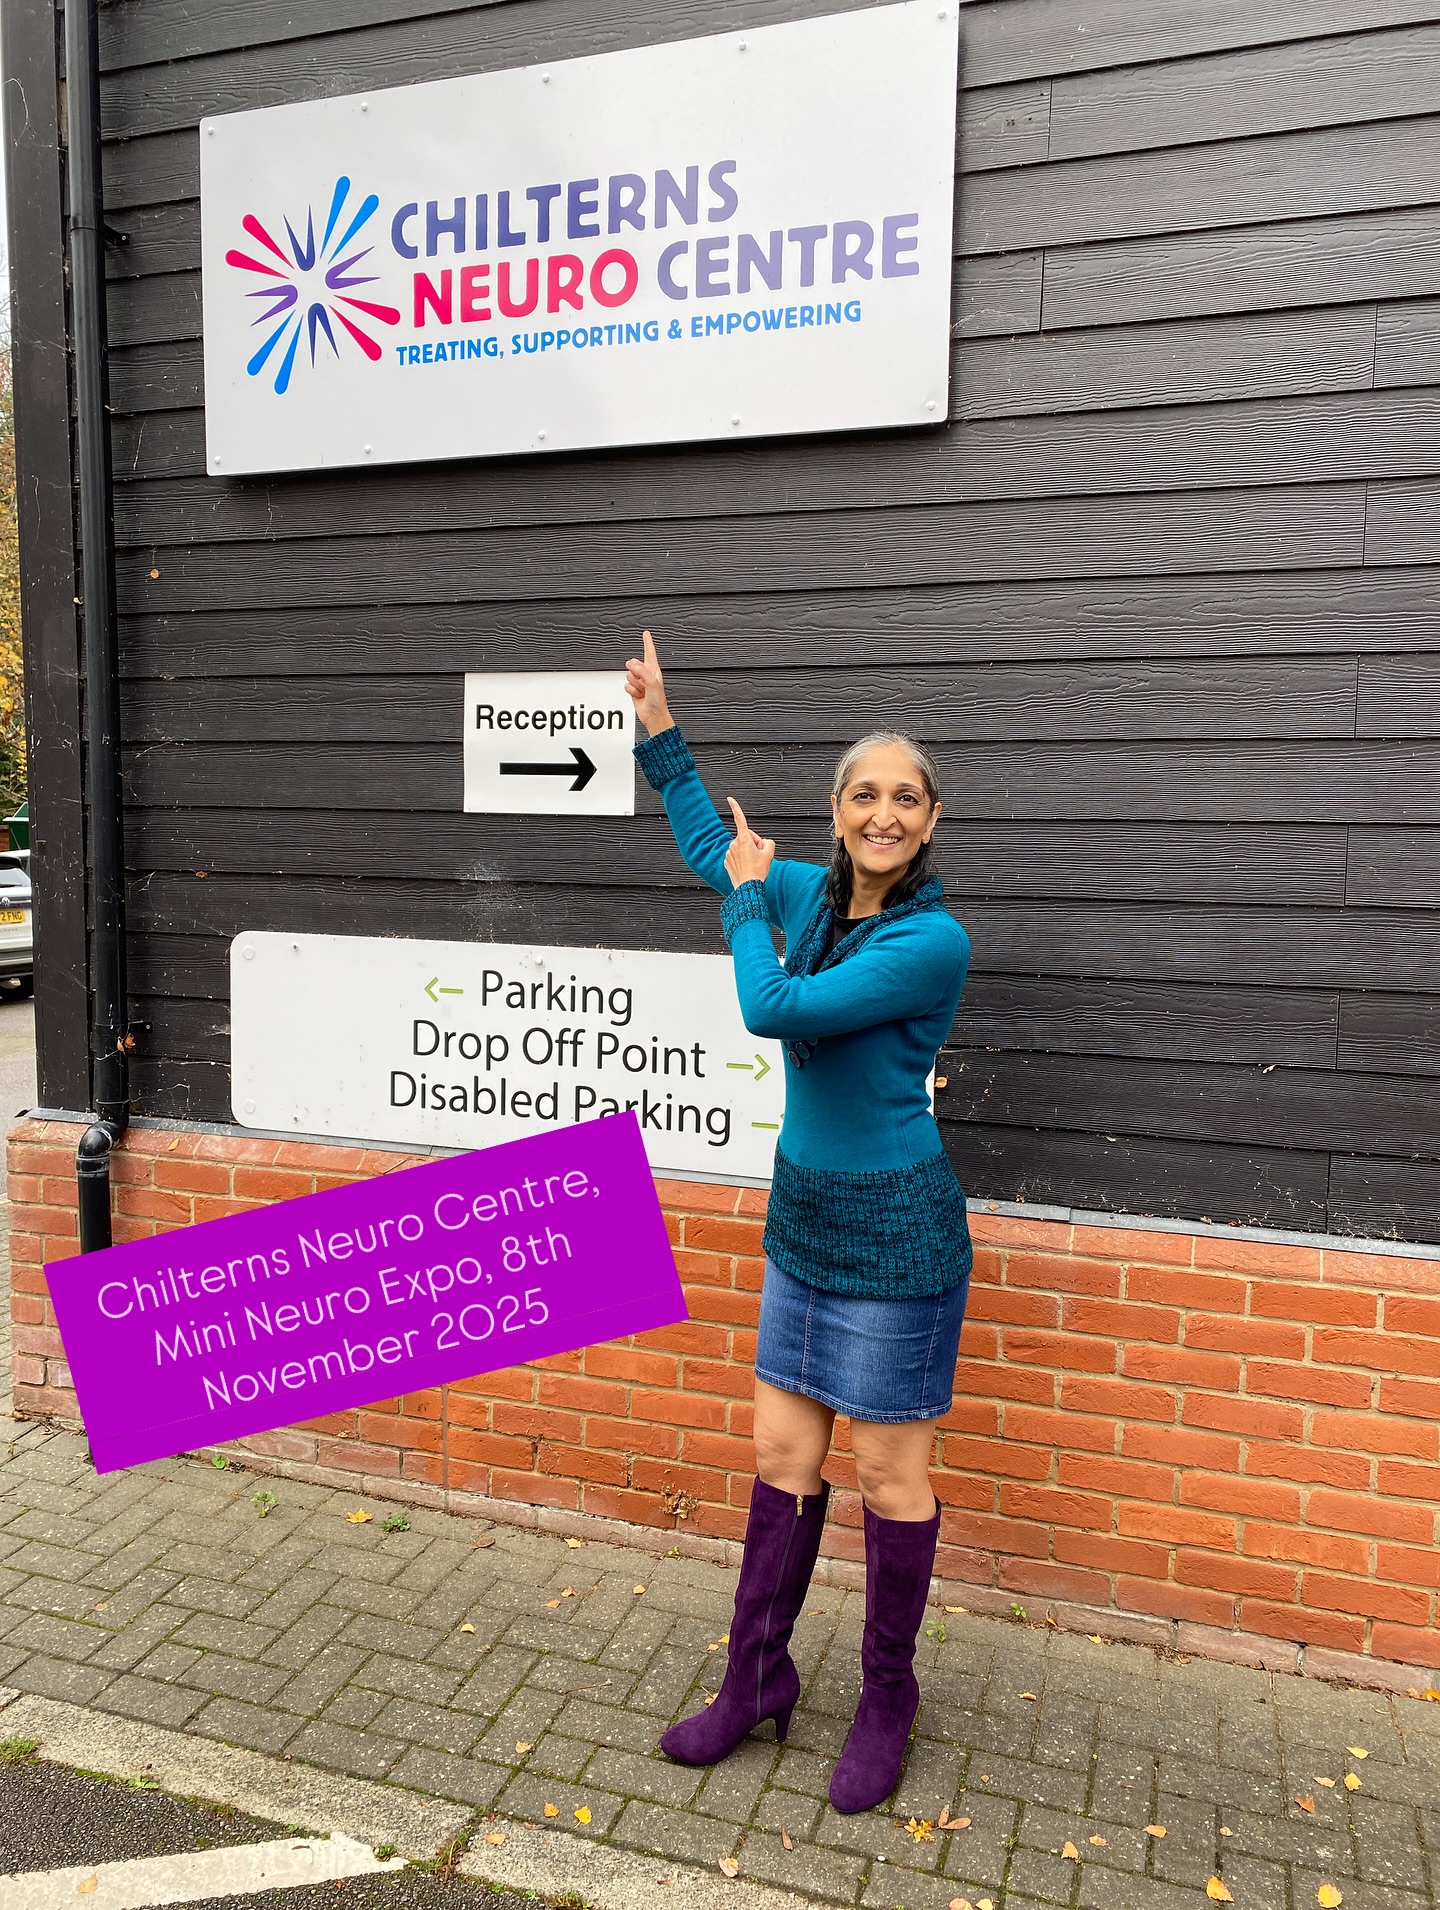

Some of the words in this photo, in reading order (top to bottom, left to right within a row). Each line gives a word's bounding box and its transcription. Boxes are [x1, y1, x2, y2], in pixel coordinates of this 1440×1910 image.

[391, 160, 738, 259] CHILTERNS
[412, 248, 638, 328] NEURO
[657, 213, 920, 300] CENTRE
[396, 334, 505, 366] TREATING,
[511, 320, 660, 356] SUPPORTING
[667, 318, 683, 340] &
[690, 300, 861, 338] EMPOWERING
[475, 704, 624, 737] Reception
[483, 969, 632, 1027] Parking
[413, 1019, 509, 1071] Drop
[523, 1027, 586, 1068] Off
[597, 1032, 706, 1078] Point
[390, 1070, 559, 1121] Disabled
